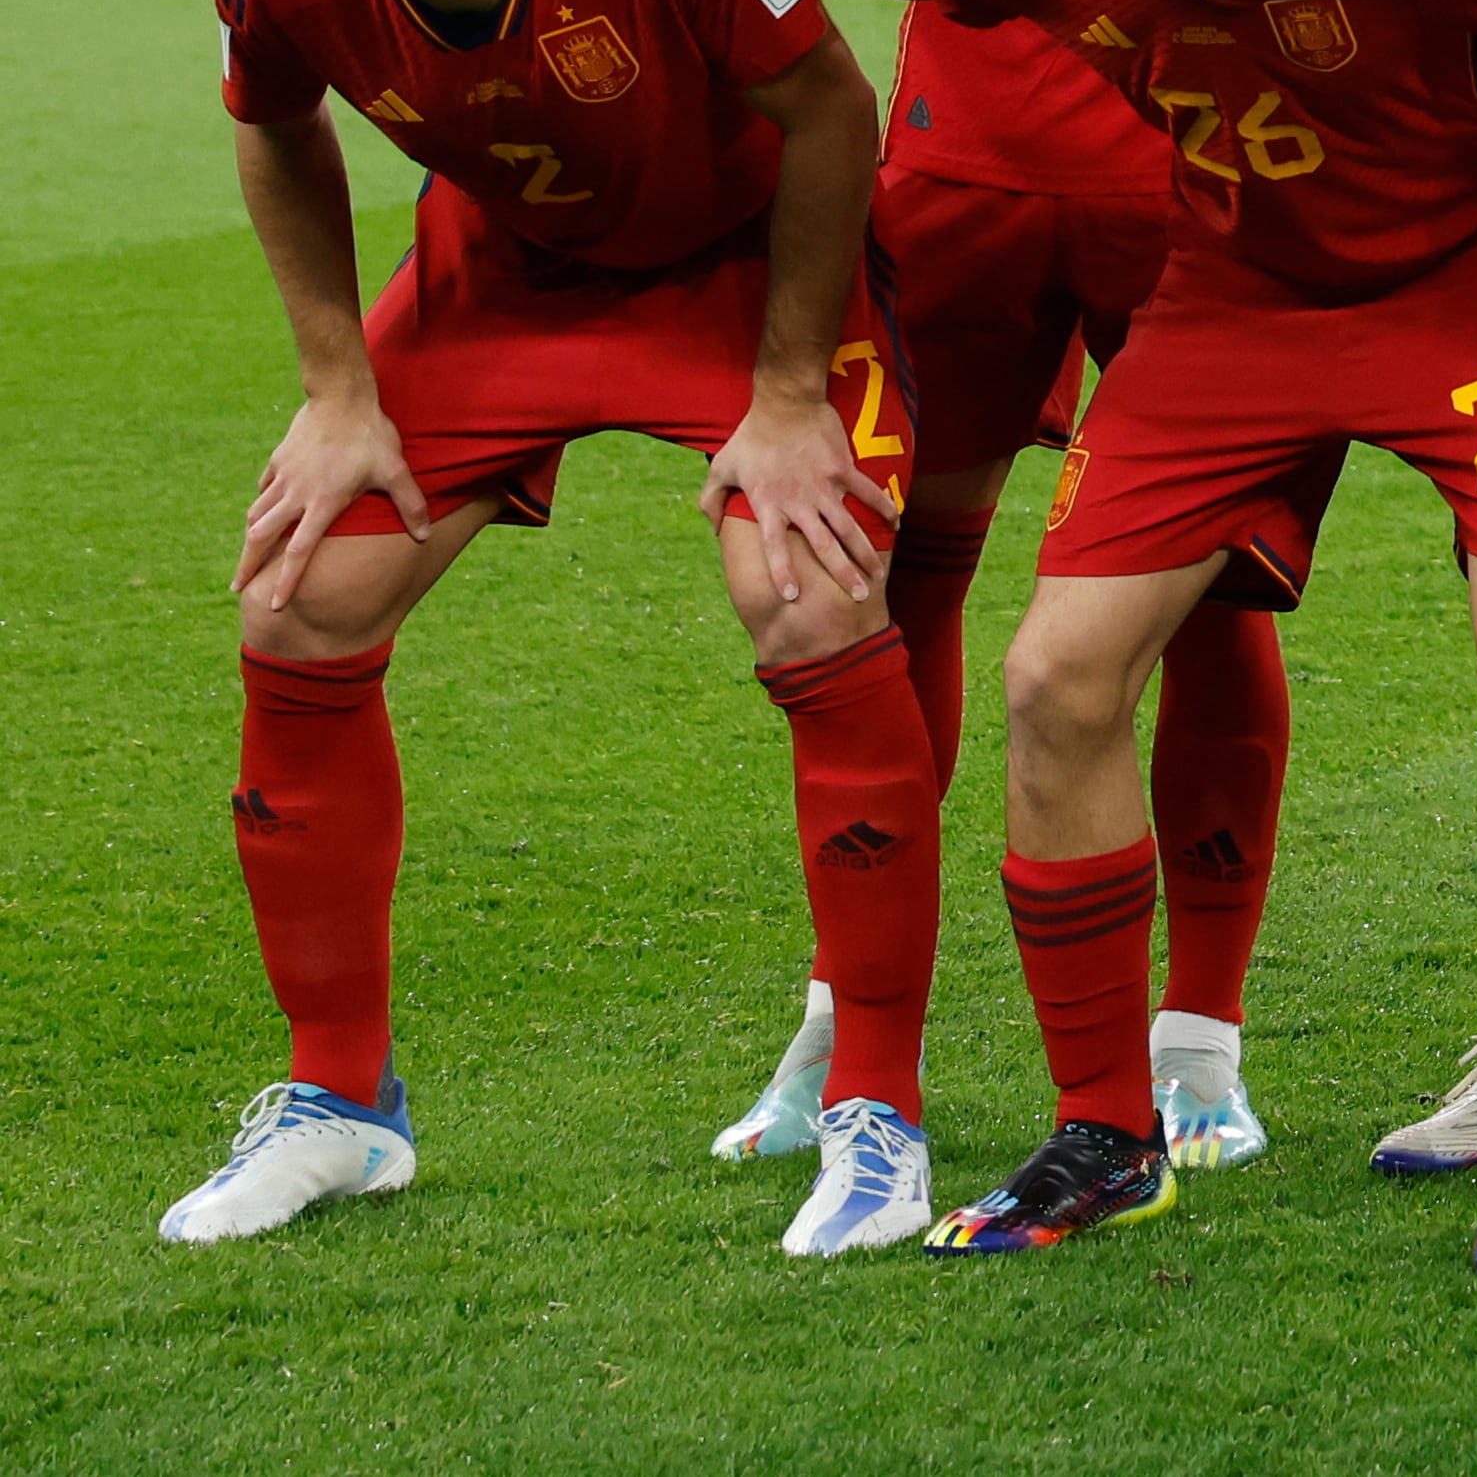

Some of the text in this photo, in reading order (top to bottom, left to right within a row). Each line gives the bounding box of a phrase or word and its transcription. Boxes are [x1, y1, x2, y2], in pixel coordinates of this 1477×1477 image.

[490, 142, 596, 204] 2
[1149, 89, 1325, 182] 26
[829, 339, 905, 461] 2
